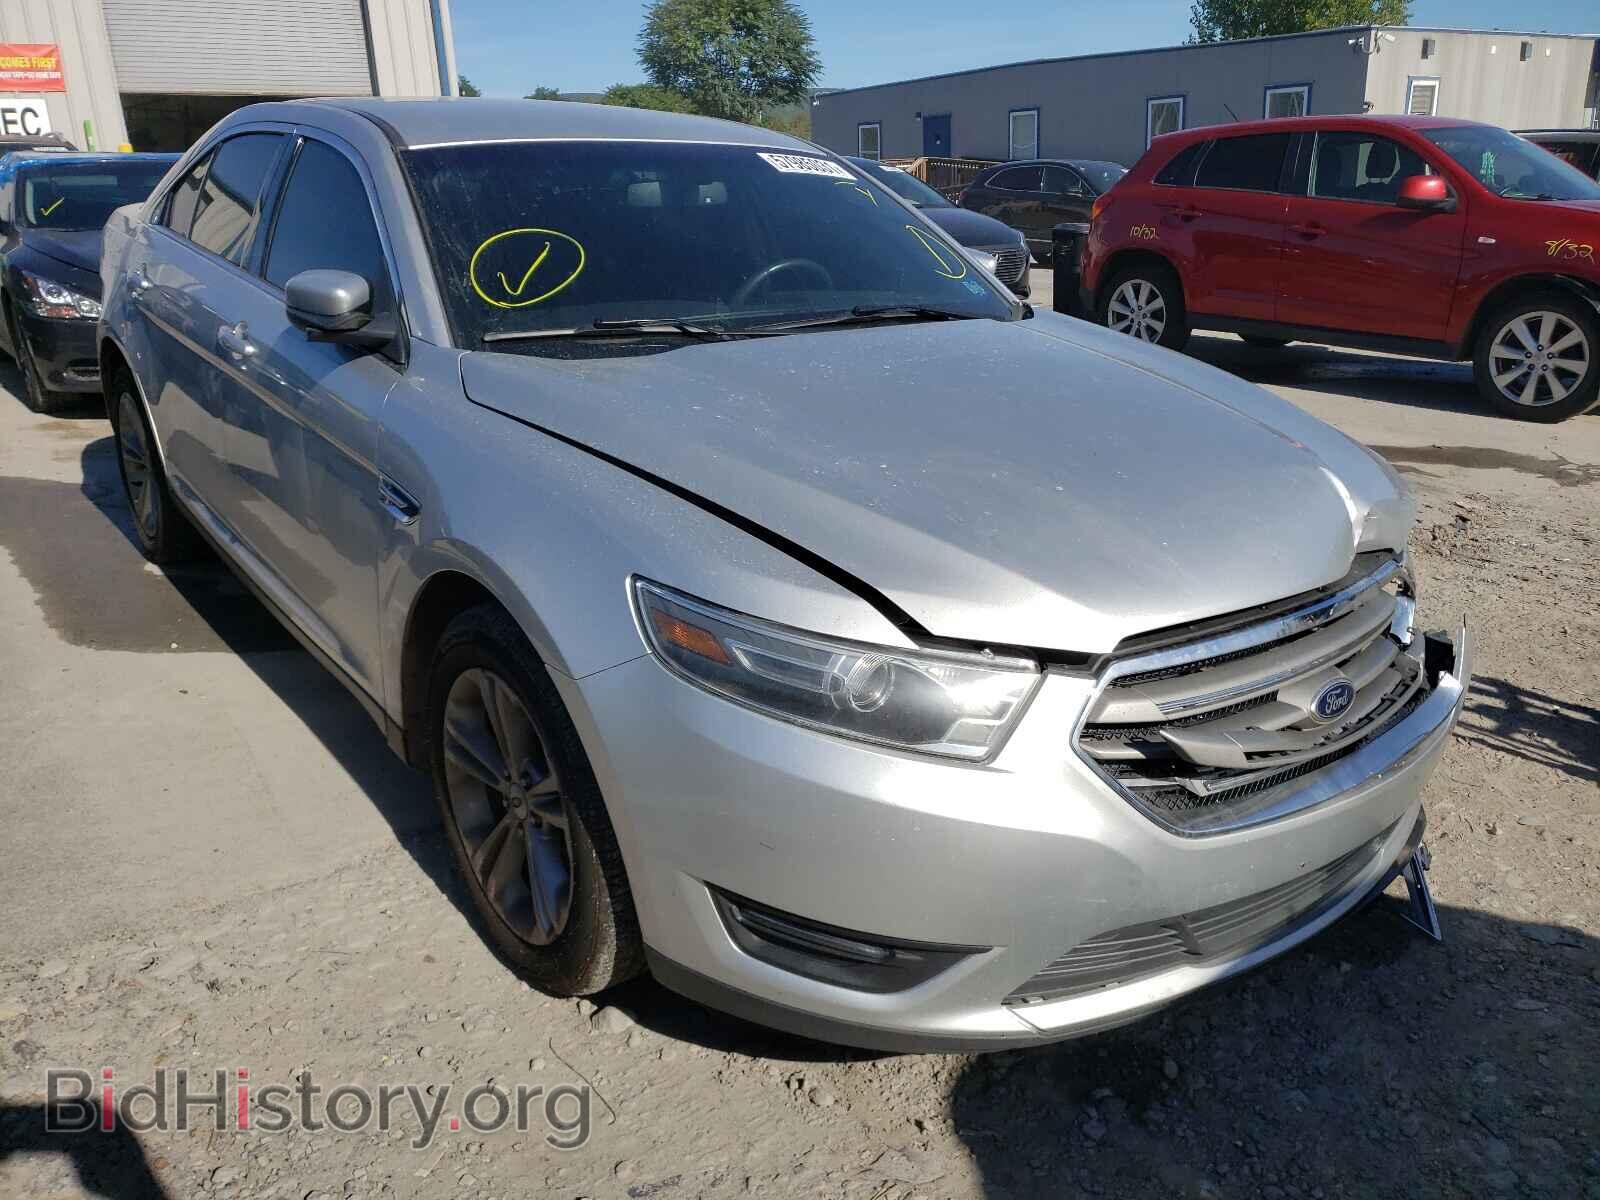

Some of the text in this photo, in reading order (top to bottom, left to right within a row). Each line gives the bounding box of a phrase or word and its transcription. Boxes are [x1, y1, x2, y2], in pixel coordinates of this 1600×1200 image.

[0, 107, 41, 135] EC
[1129, 224, 1160, 240] 10/32
[1544, 238, 1595, 264] 8/32
